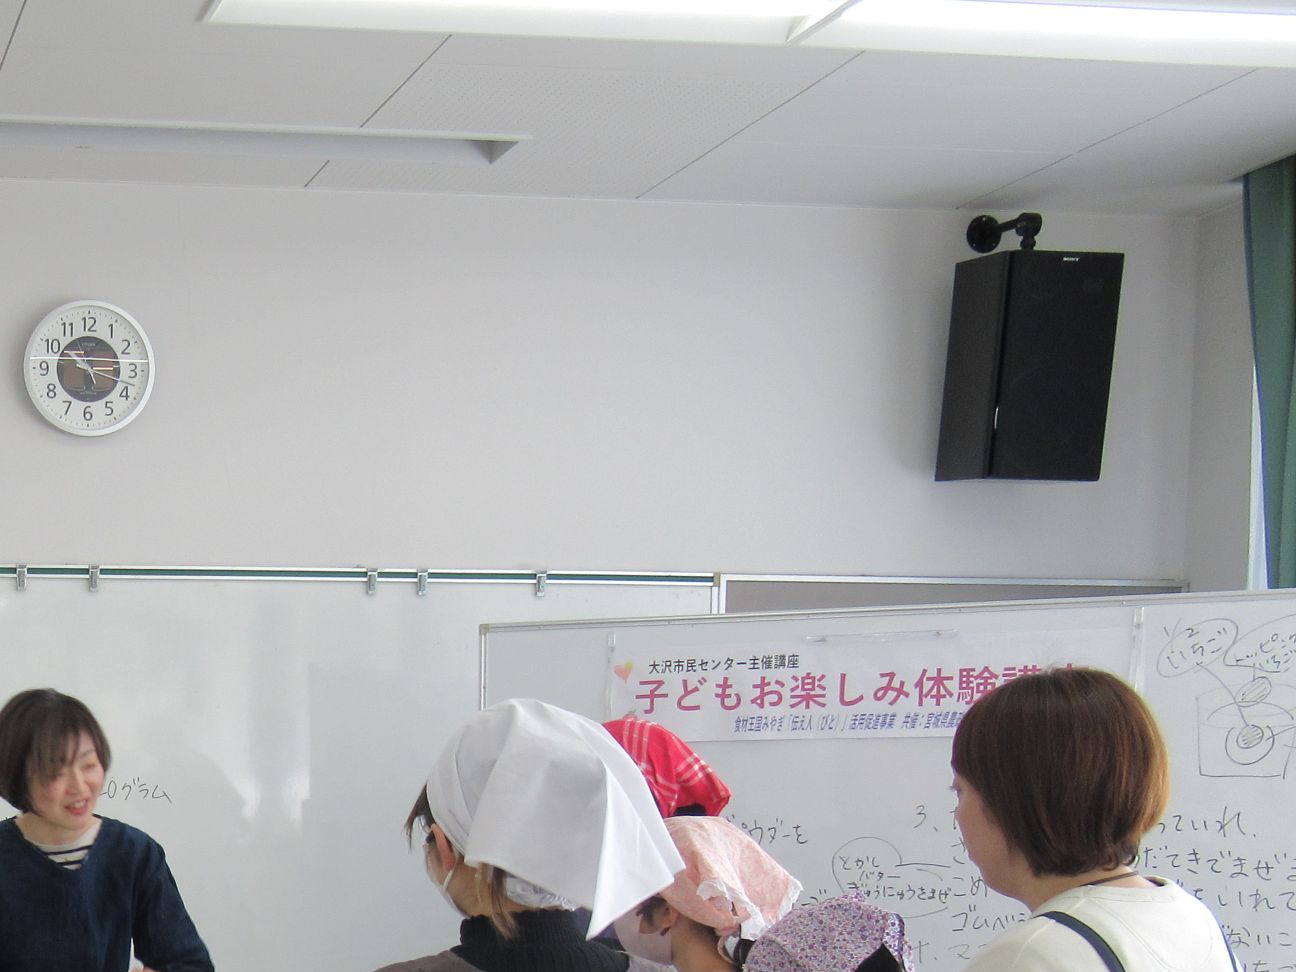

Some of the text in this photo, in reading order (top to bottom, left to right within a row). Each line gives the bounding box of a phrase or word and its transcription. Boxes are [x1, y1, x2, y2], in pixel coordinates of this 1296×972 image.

[61, 322, 74, 337] 11
[81, 316, 97, 332] 12
[108, 324, 114, 339] 1
[45, 339, 61, 354] 10
[121, 340, 131, 355] 2
[39, 361, 49, 376] 9
[128, 363, 138, 378] 3
[46, 384, 57, 398] 8
[119, 386, 130, 400] 4
[62, 401, 72, 415] 7
[83, 406, 93, 421] 6
[104, 401, 114, 416] 5
[648, 654, 800, 675] 大沢市民センター主催講座
[635, 663, 1073, 715] 子どもお楽しみ体験
[99, 776, 172, 804] 0グラム
